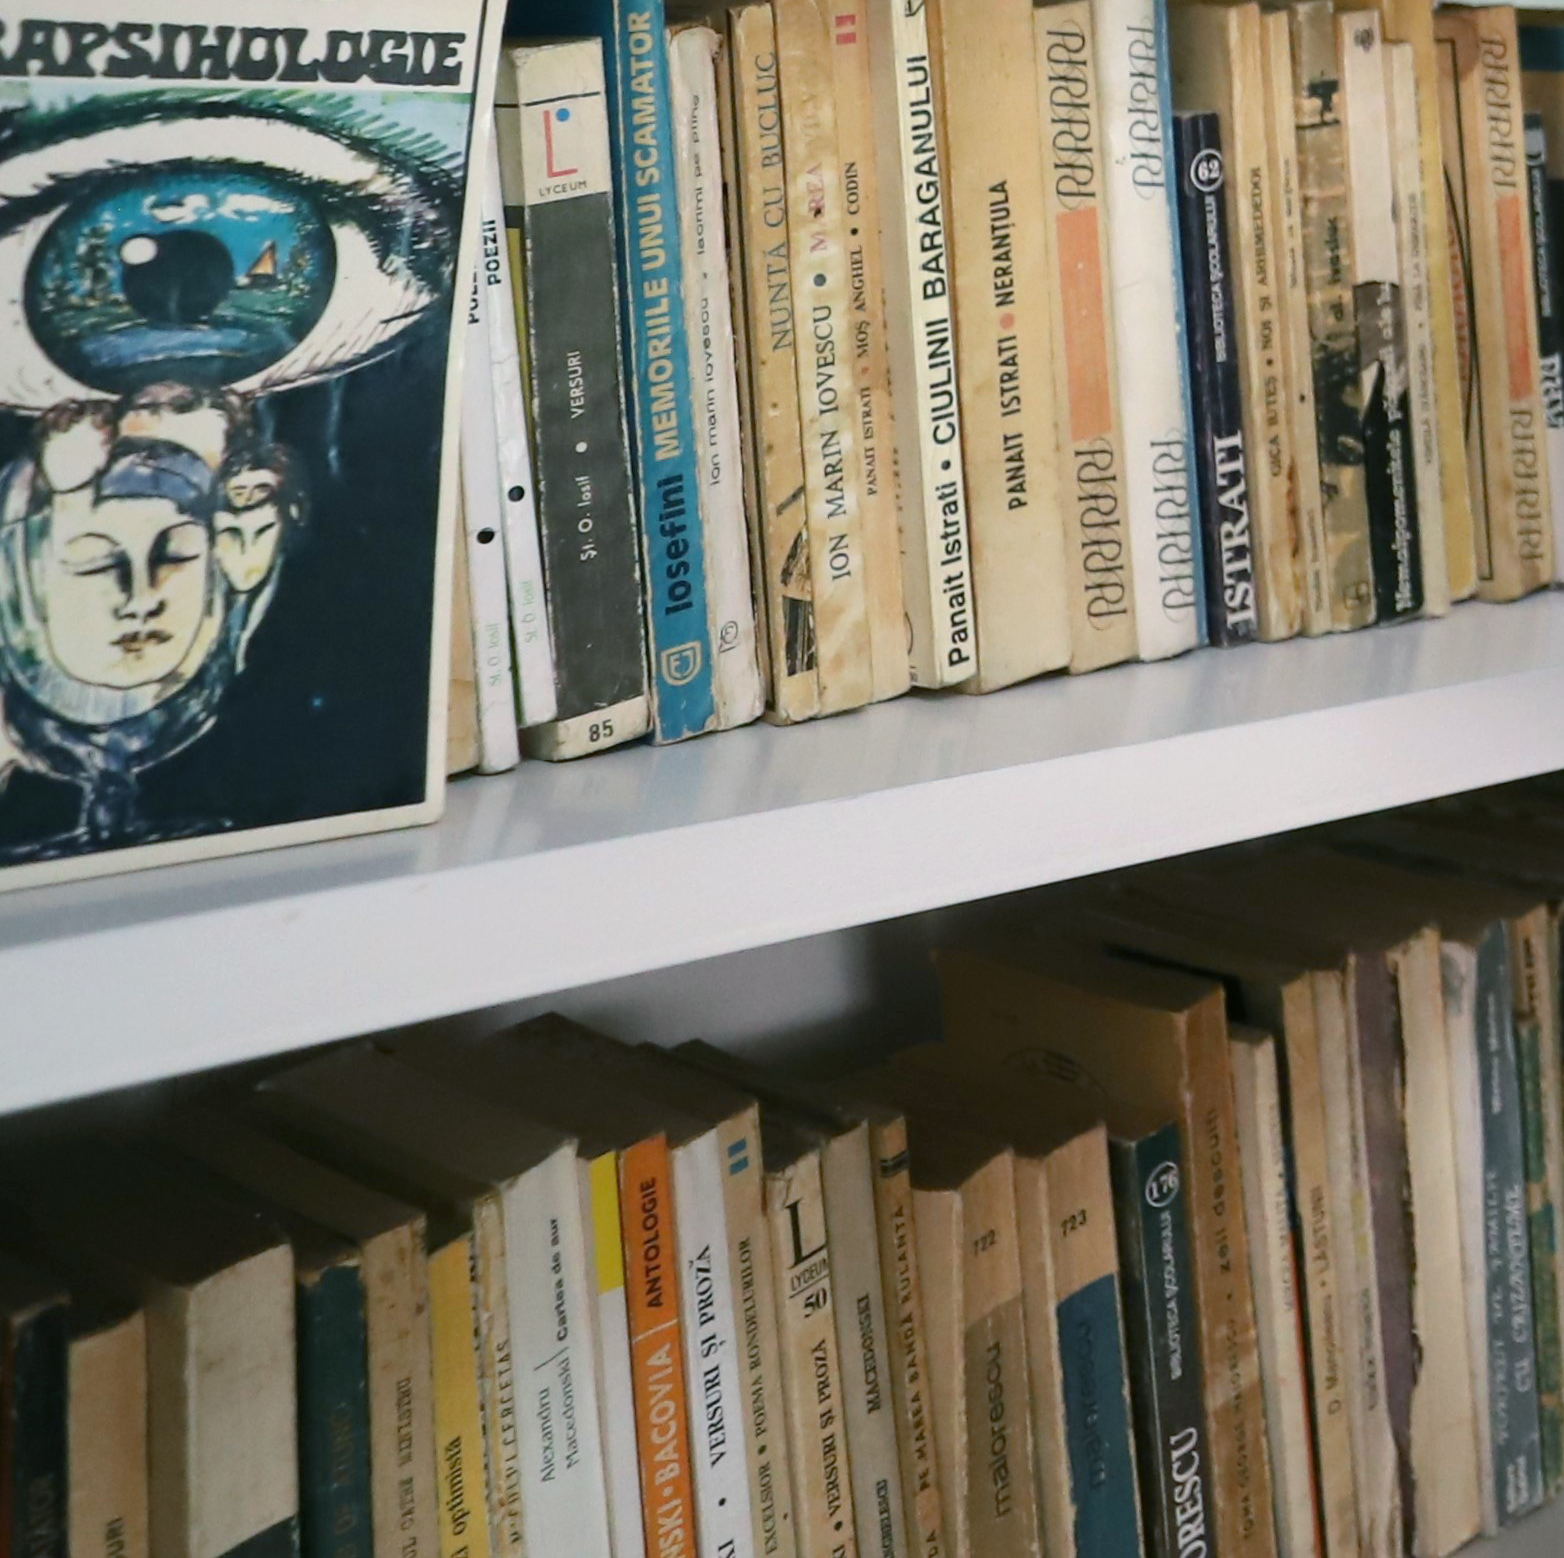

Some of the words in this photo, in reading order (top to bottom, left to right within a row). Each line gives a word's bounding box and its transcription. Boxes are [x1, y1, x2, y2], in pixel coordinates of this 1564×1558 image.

[0, 18, 466, 88] APSIHOLOGIE
[626, 11, 660, 187] SCAMATOR
[753, 51, 784, 169] BUCLUC
[537, 178, 589, 197] LYCEUM
[761, 185, 787, 228] CU
[844, 161, 861, 216] CODIN
[486, 218, 503, 286] POEZII
[633, 192, 665, 271] UNUI
[987, 179, 1017, 307] NERANȚULA
[850, 245, 866, 313] ANGHEL
[640, 277, 681, 461] MEMORIILE
[699, 296, 715, 383] iovescu
[811, 303, 840, 416] IOVESCU
[926, 317, 959, 446] CIULINII
[997, 333, 1022, 418] ISTRATI
[567, 350, 585, 419] VERSURI
[702, 388, 719, 447] marin
[705, 452, 723, 486] ion
[819, 428, 850, 519] MARIN
[1001, 431, 1029, 510] PANAIT
[657, 473, 694, 616] Iosefini
[826, 532, 854, 582] ION
[935, 480, 963, 565] Istrati
[1212, 429, 1256, 630] ISTRATI
[943, 571, 971, 666] Panait
[588, 719, 613, 743] 85
[550, 1251, 563, 1275] de
[639, 1177, 664, 1309] ANTOLOGIE
[687, 1244, 717, 1324] PROZĂ
[553, 1278, 570, 1342] Cartea
[699, 1332, 726, 1355] ȘI
[534, 1387, 556, 1483] Alexandru
[557, 1357, 581, 1470] Macedonski
[645, 1342, 681, 1485] BACOVIA
[702, 1365, 728, 1467] VERSURI
[750, 1372, 767, 1439] POEMA
[981, 1341, 1013, 1519] maiorescu
[757, 1460, 778, 1555] EXCELSIOR
[820, 1432, 843, 1517] VERSURI
